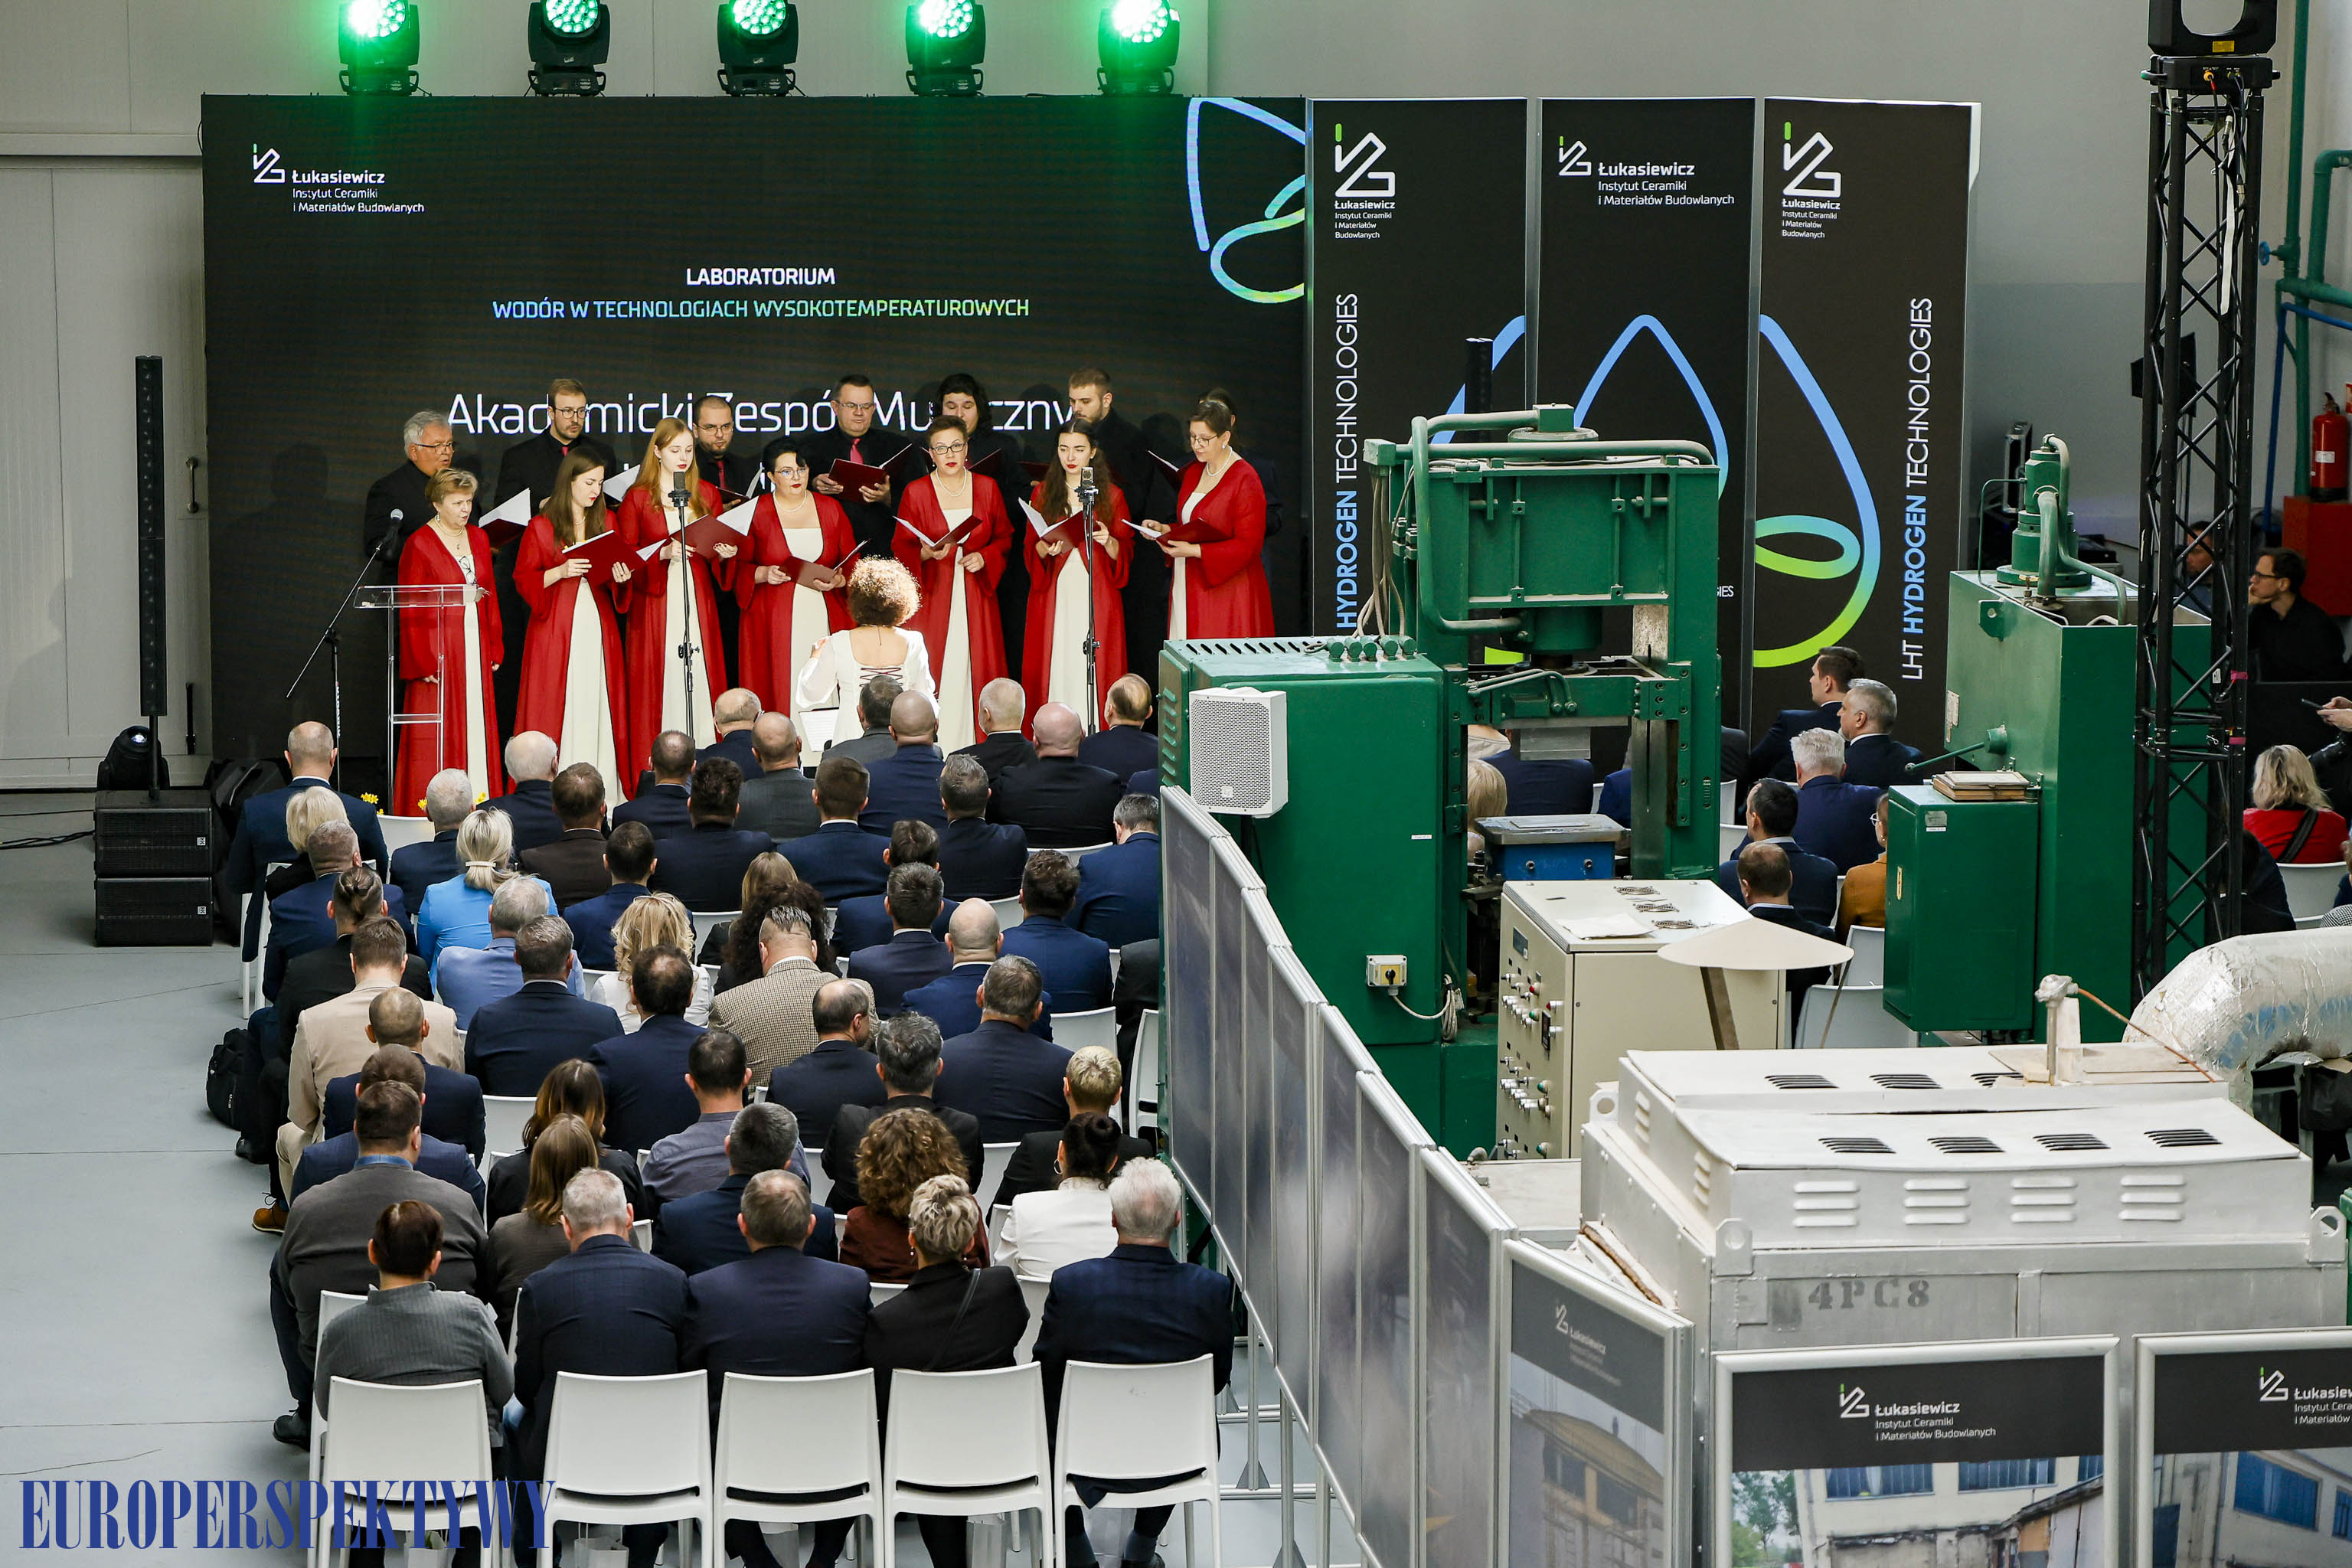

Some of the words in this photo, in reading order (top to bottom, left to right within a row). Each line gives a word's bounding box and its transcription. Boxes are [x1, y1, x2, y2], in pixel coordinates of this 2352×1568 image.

[1598, 162, 1695, 176] Łukasiewicz
[292, 169, 385, 184] Łukasiewicz
[1599, 181, 1639, 192] Instytut
[1642, 180, 1687, 191] Ceramiki
[292, 188, 332, 200] Instytut
[335, 188, 378, 198] Ceramiki
[1599, 196, 1602, 205] i
[1604, 194, 1663, 205] Materiałów
[1665, 194, 1735, 206] Budowlanych
[299, 201, 355, 213] Materiałów
[358, 202, 425, 214] Budowlanych
[1334, 200, 1396, 209] Łukasiewicz
[1782, 198, 1841, 210] Łukasiewicz
[1782, 210, 1808, 218] Instytut
[1785, 220, 1822, 228] Materiałów
[1334, 231, 1380, 240] Budowlanych
[1782, 229, 1825, 239] Budowlanych
[686, 268, 835, 285] LABORATORIUM
[492, 296, 565, 318] WODÓR
[570, 300, 590, 318] W
[593, 299, 748, 318] TECHNOLOGIACH
[753, 299, 1029, 317] WYSOKOTEMPERATUROWYCH
[1335, 292, 1359, 484] TECHNOLOGIES
[1906, 297, 1932, 488] TECHNOLOGIES
[448, 392, 694, 434] Akadmicki
[1335, 490, 1358, 628] HYDROGEN
[1902, 495, 1927, 634] HYDROGEN
[1902, 640, 1923, 680] LHT
[1875, 1401, 1960, 1416] Łukasiewicz
[2295, 1403, 2329, 1413] Instytut
[1876, 1419, 1912, 1430] Instytut
[1914, 1417, 1954, 1427] Ceramiki
[2300, 1413, 2350, 1424] Materiałów
[1881, 1430, 1932, 1441] Materiałów
[1935, 1427, 1997, 1439] Budowlanych
